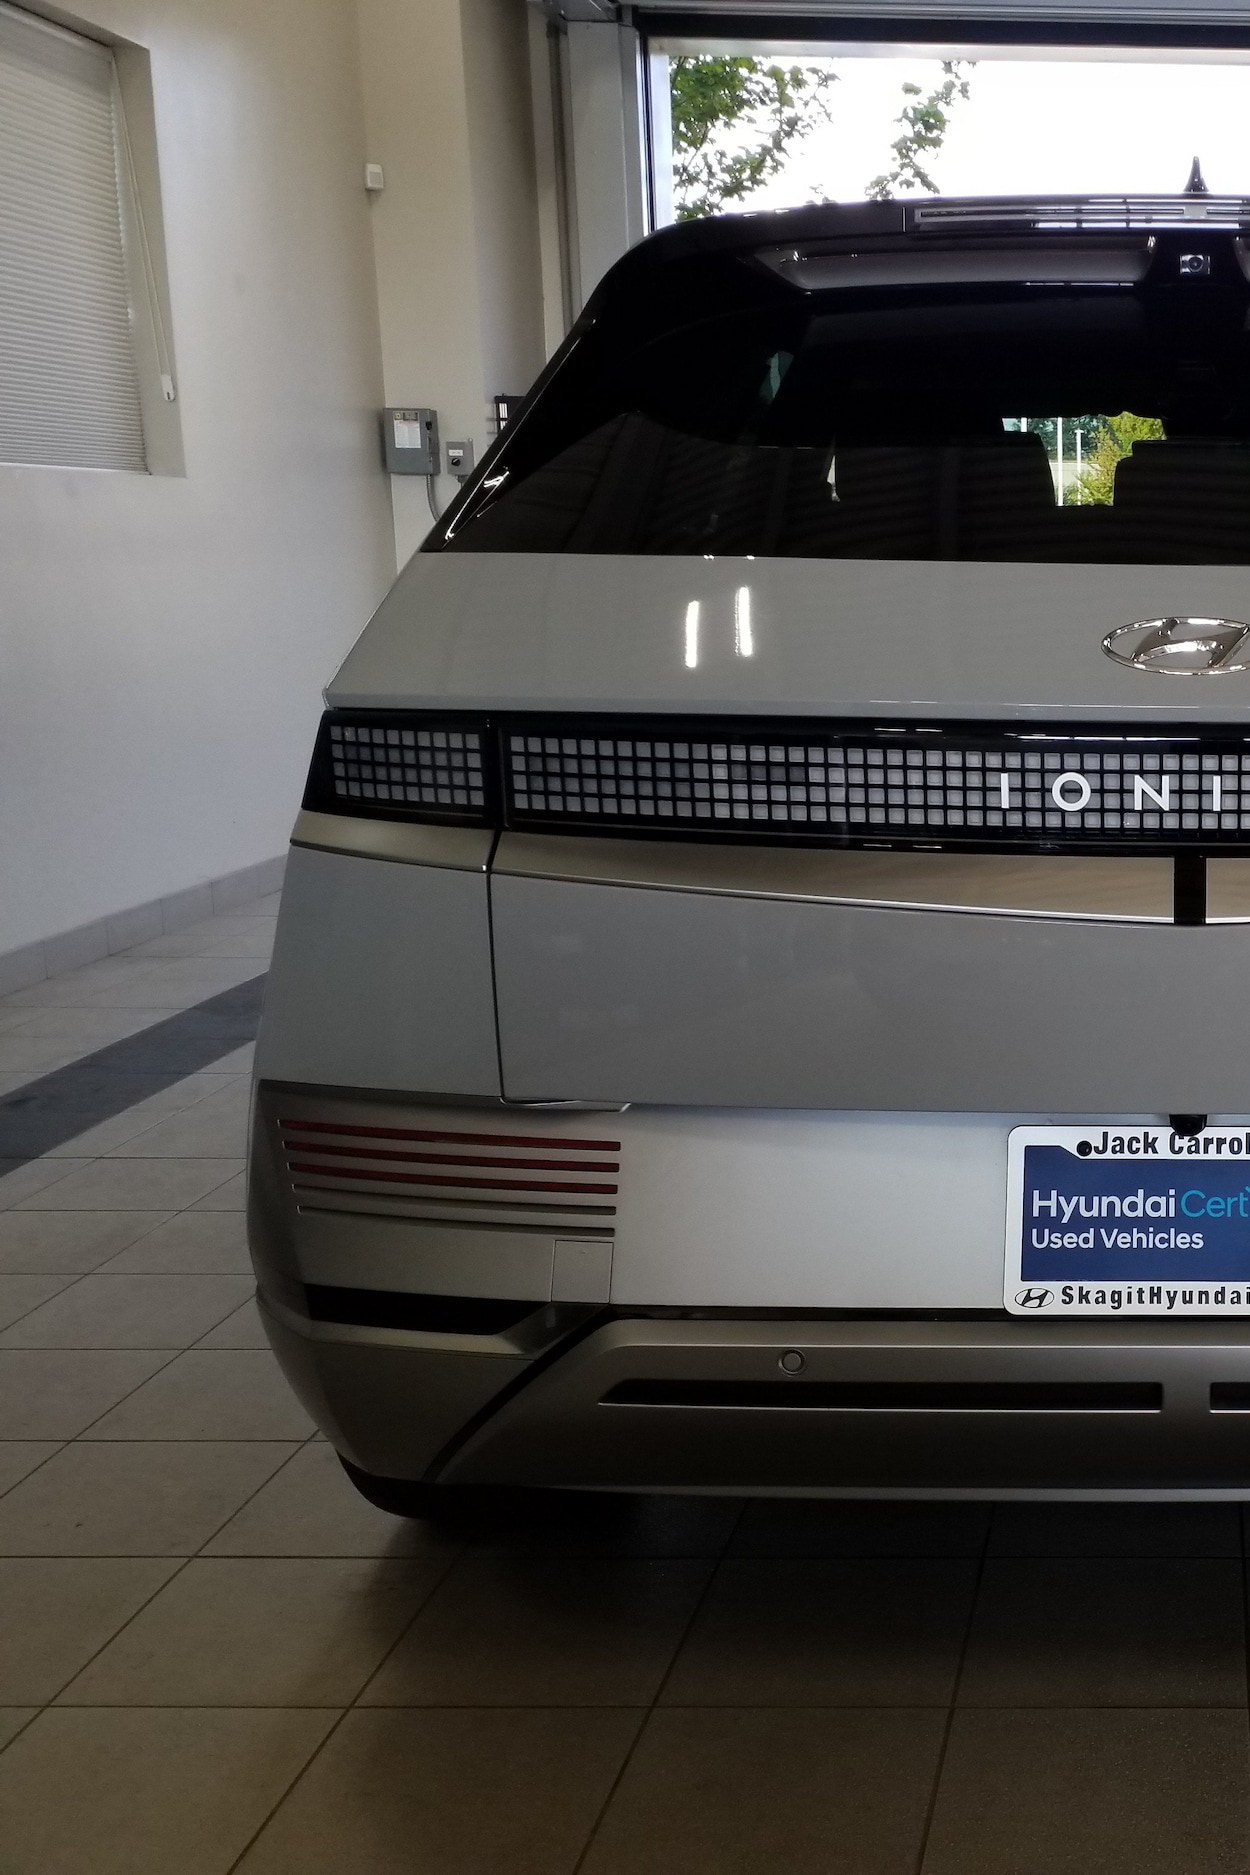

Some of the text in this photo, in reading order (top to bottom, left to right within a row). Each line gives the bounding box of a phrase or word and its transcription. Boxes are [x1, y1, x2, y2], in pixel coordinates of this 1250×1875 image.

[1093, 1131, 1159, 1155] Jack
[1032, 1188, 1176, 1224] Hyundai
[1031, 1228, 1205, 1249] Used Vehicles
